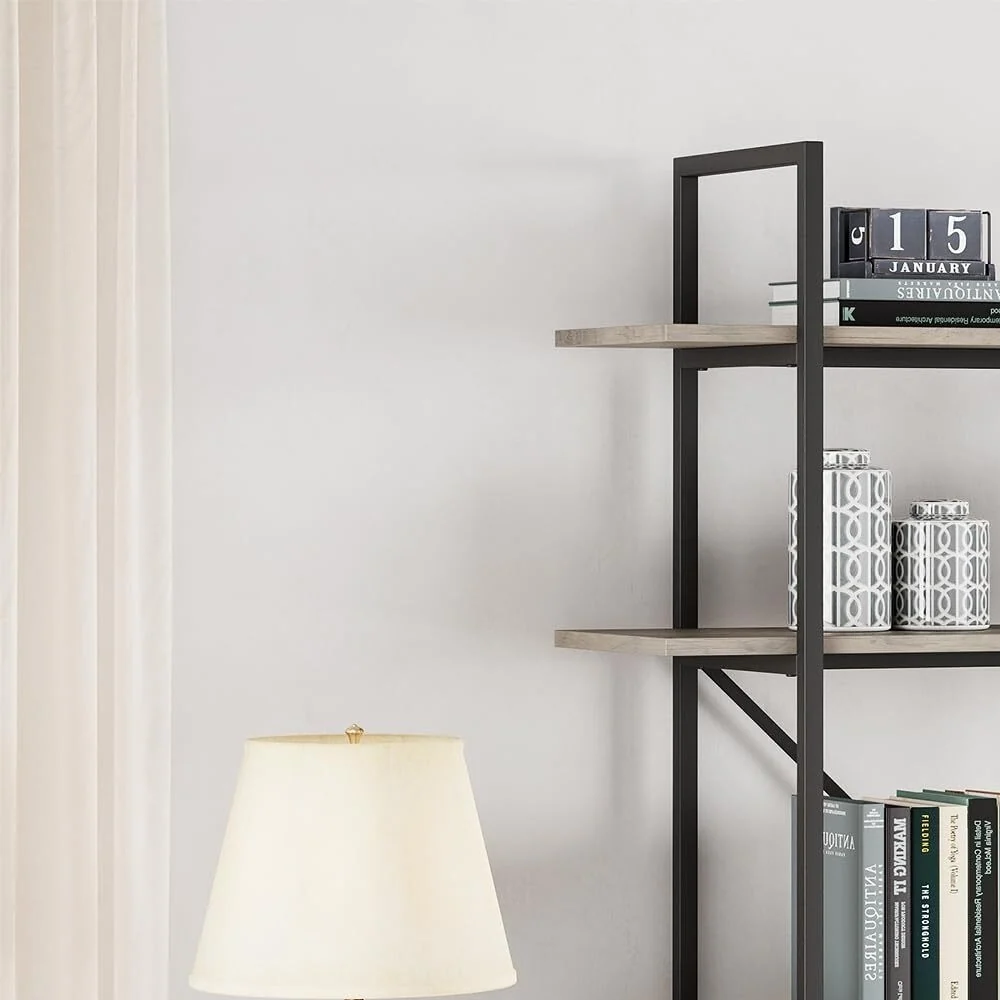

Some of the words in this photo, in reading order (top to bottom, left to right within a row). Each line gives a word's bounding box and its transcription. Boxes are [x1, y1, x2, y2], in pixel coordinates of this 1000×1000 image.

[888, 211, 905, 251] 1
[946, 215, 968, 254] 5
[888, 261, 972, 274] JANUARY
[895, 316, 933, 324] Architecture
[934, 316, 969, 324] Residential
[950, 814, 958, 824] The
[921, 814, 929, 853] FIELDING
[949, 825, 958, 842] Poetry
[949, 849, 958, 863] Yoga
[950, 865, 958, 888] (Volume
[921, 884, 930, 900] THE
[921, 904, 930, 959] STRONGHOLD
[950, 981, 958, 999] Edited
